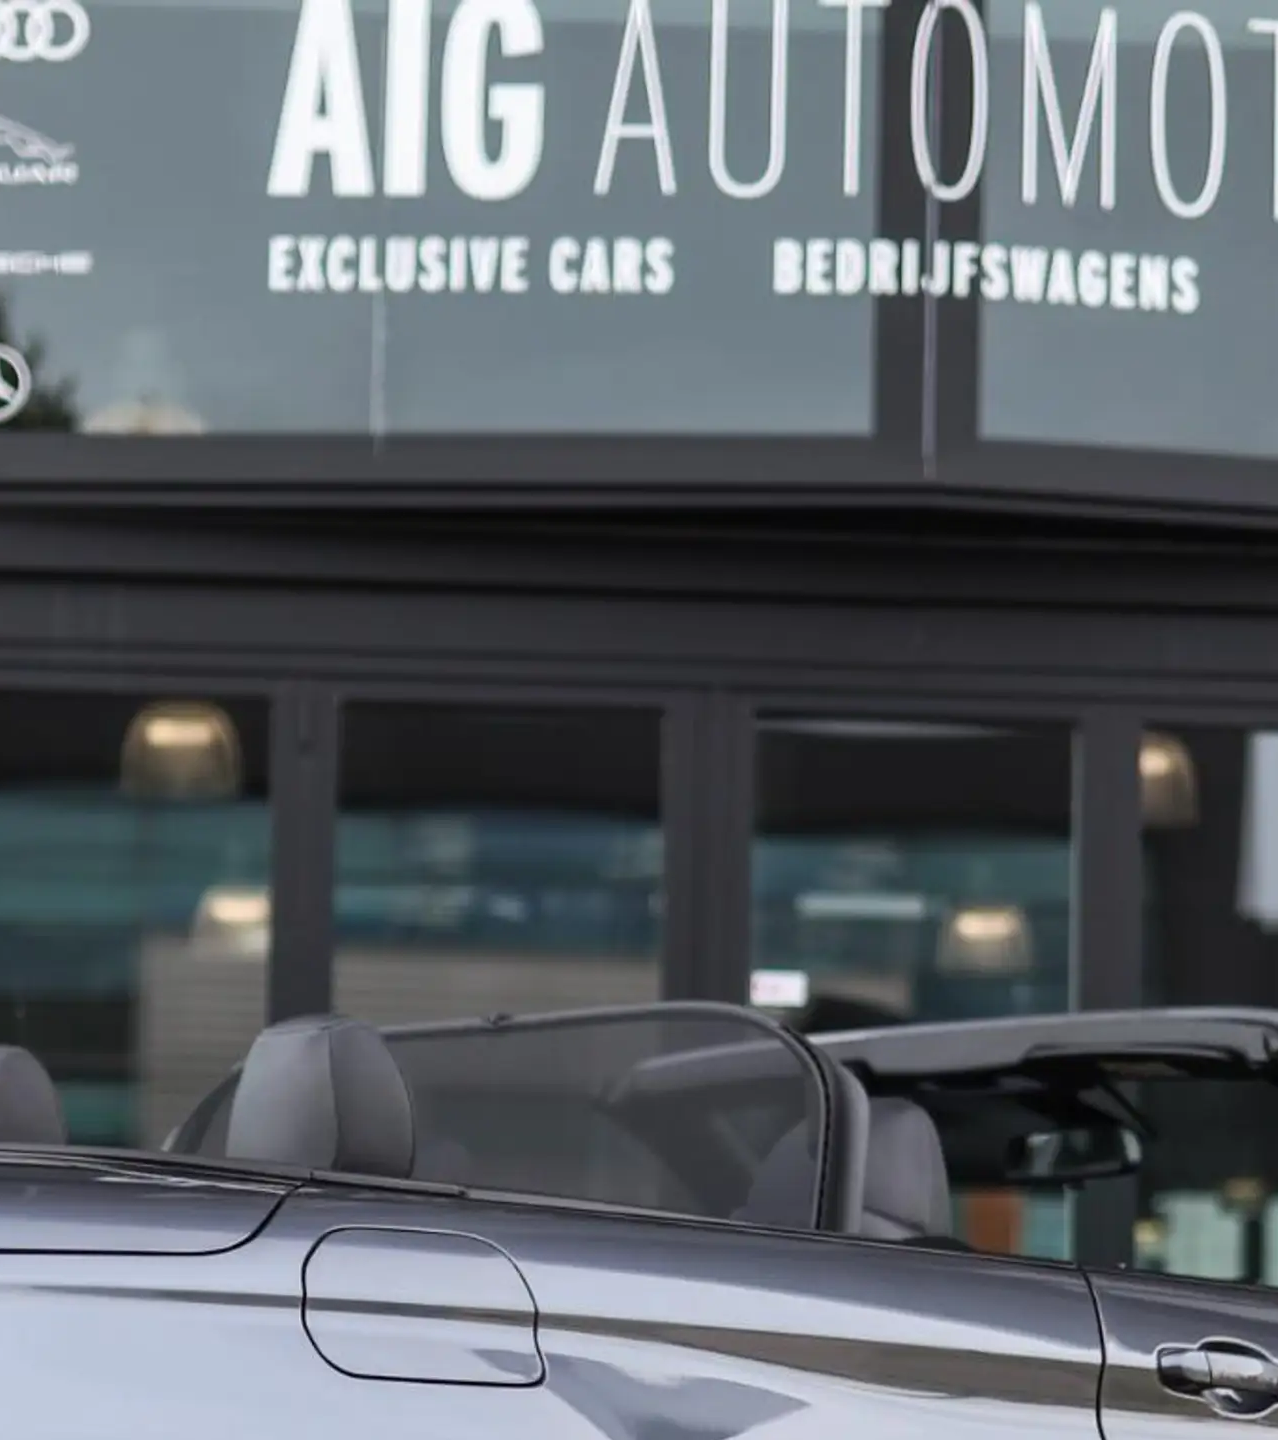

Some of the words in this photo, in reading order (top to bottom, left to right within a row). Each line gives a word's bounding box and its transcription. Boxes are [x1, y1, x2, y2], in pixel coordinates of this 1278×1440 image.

[266, 0, 545, 199] AIG
[267, 235, 529, 294] EXCLUSIVE
[549, 236, 676, 294] CARS
[773, 238, 1200, 314] BEDRIJFSWAGENS
